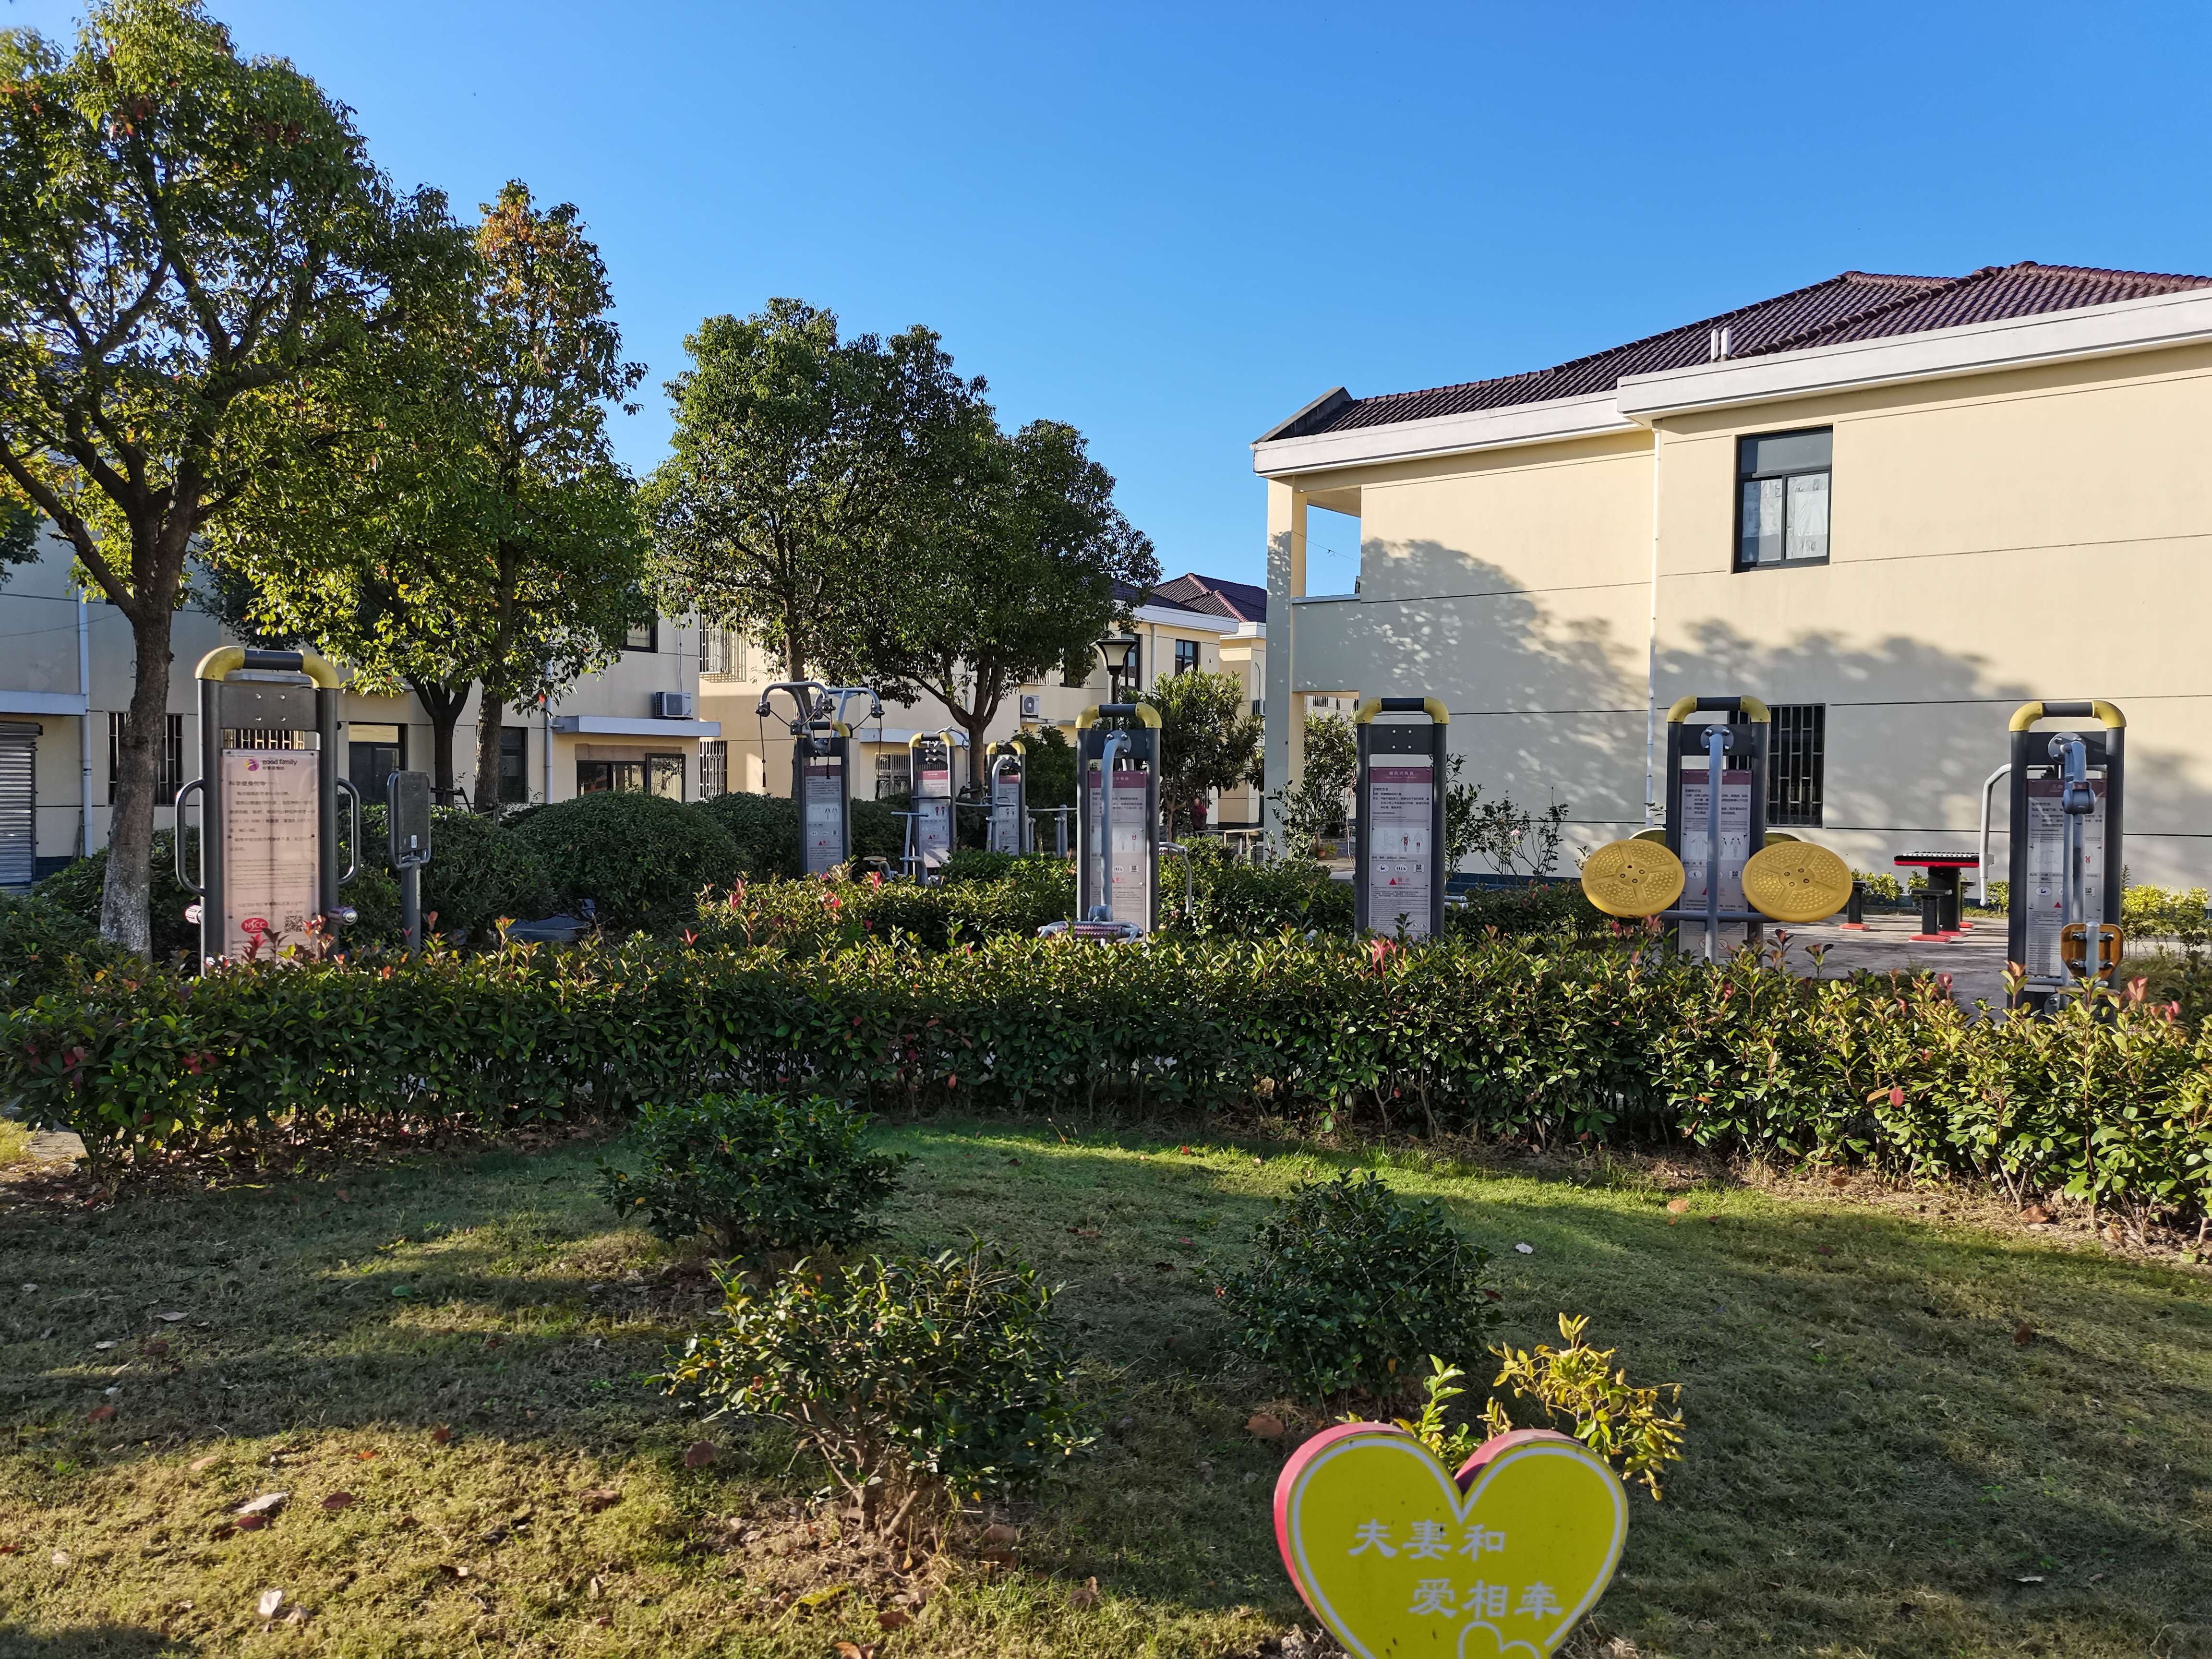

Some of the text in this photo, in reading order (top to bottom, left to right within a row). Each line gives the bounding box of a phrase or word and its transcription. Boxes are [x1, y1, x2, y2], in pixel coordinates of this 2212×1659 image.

[1348, 1518, 1506, 1562] 夫妻和
[1408, 1578, 1563, 1621] 爱相牵
